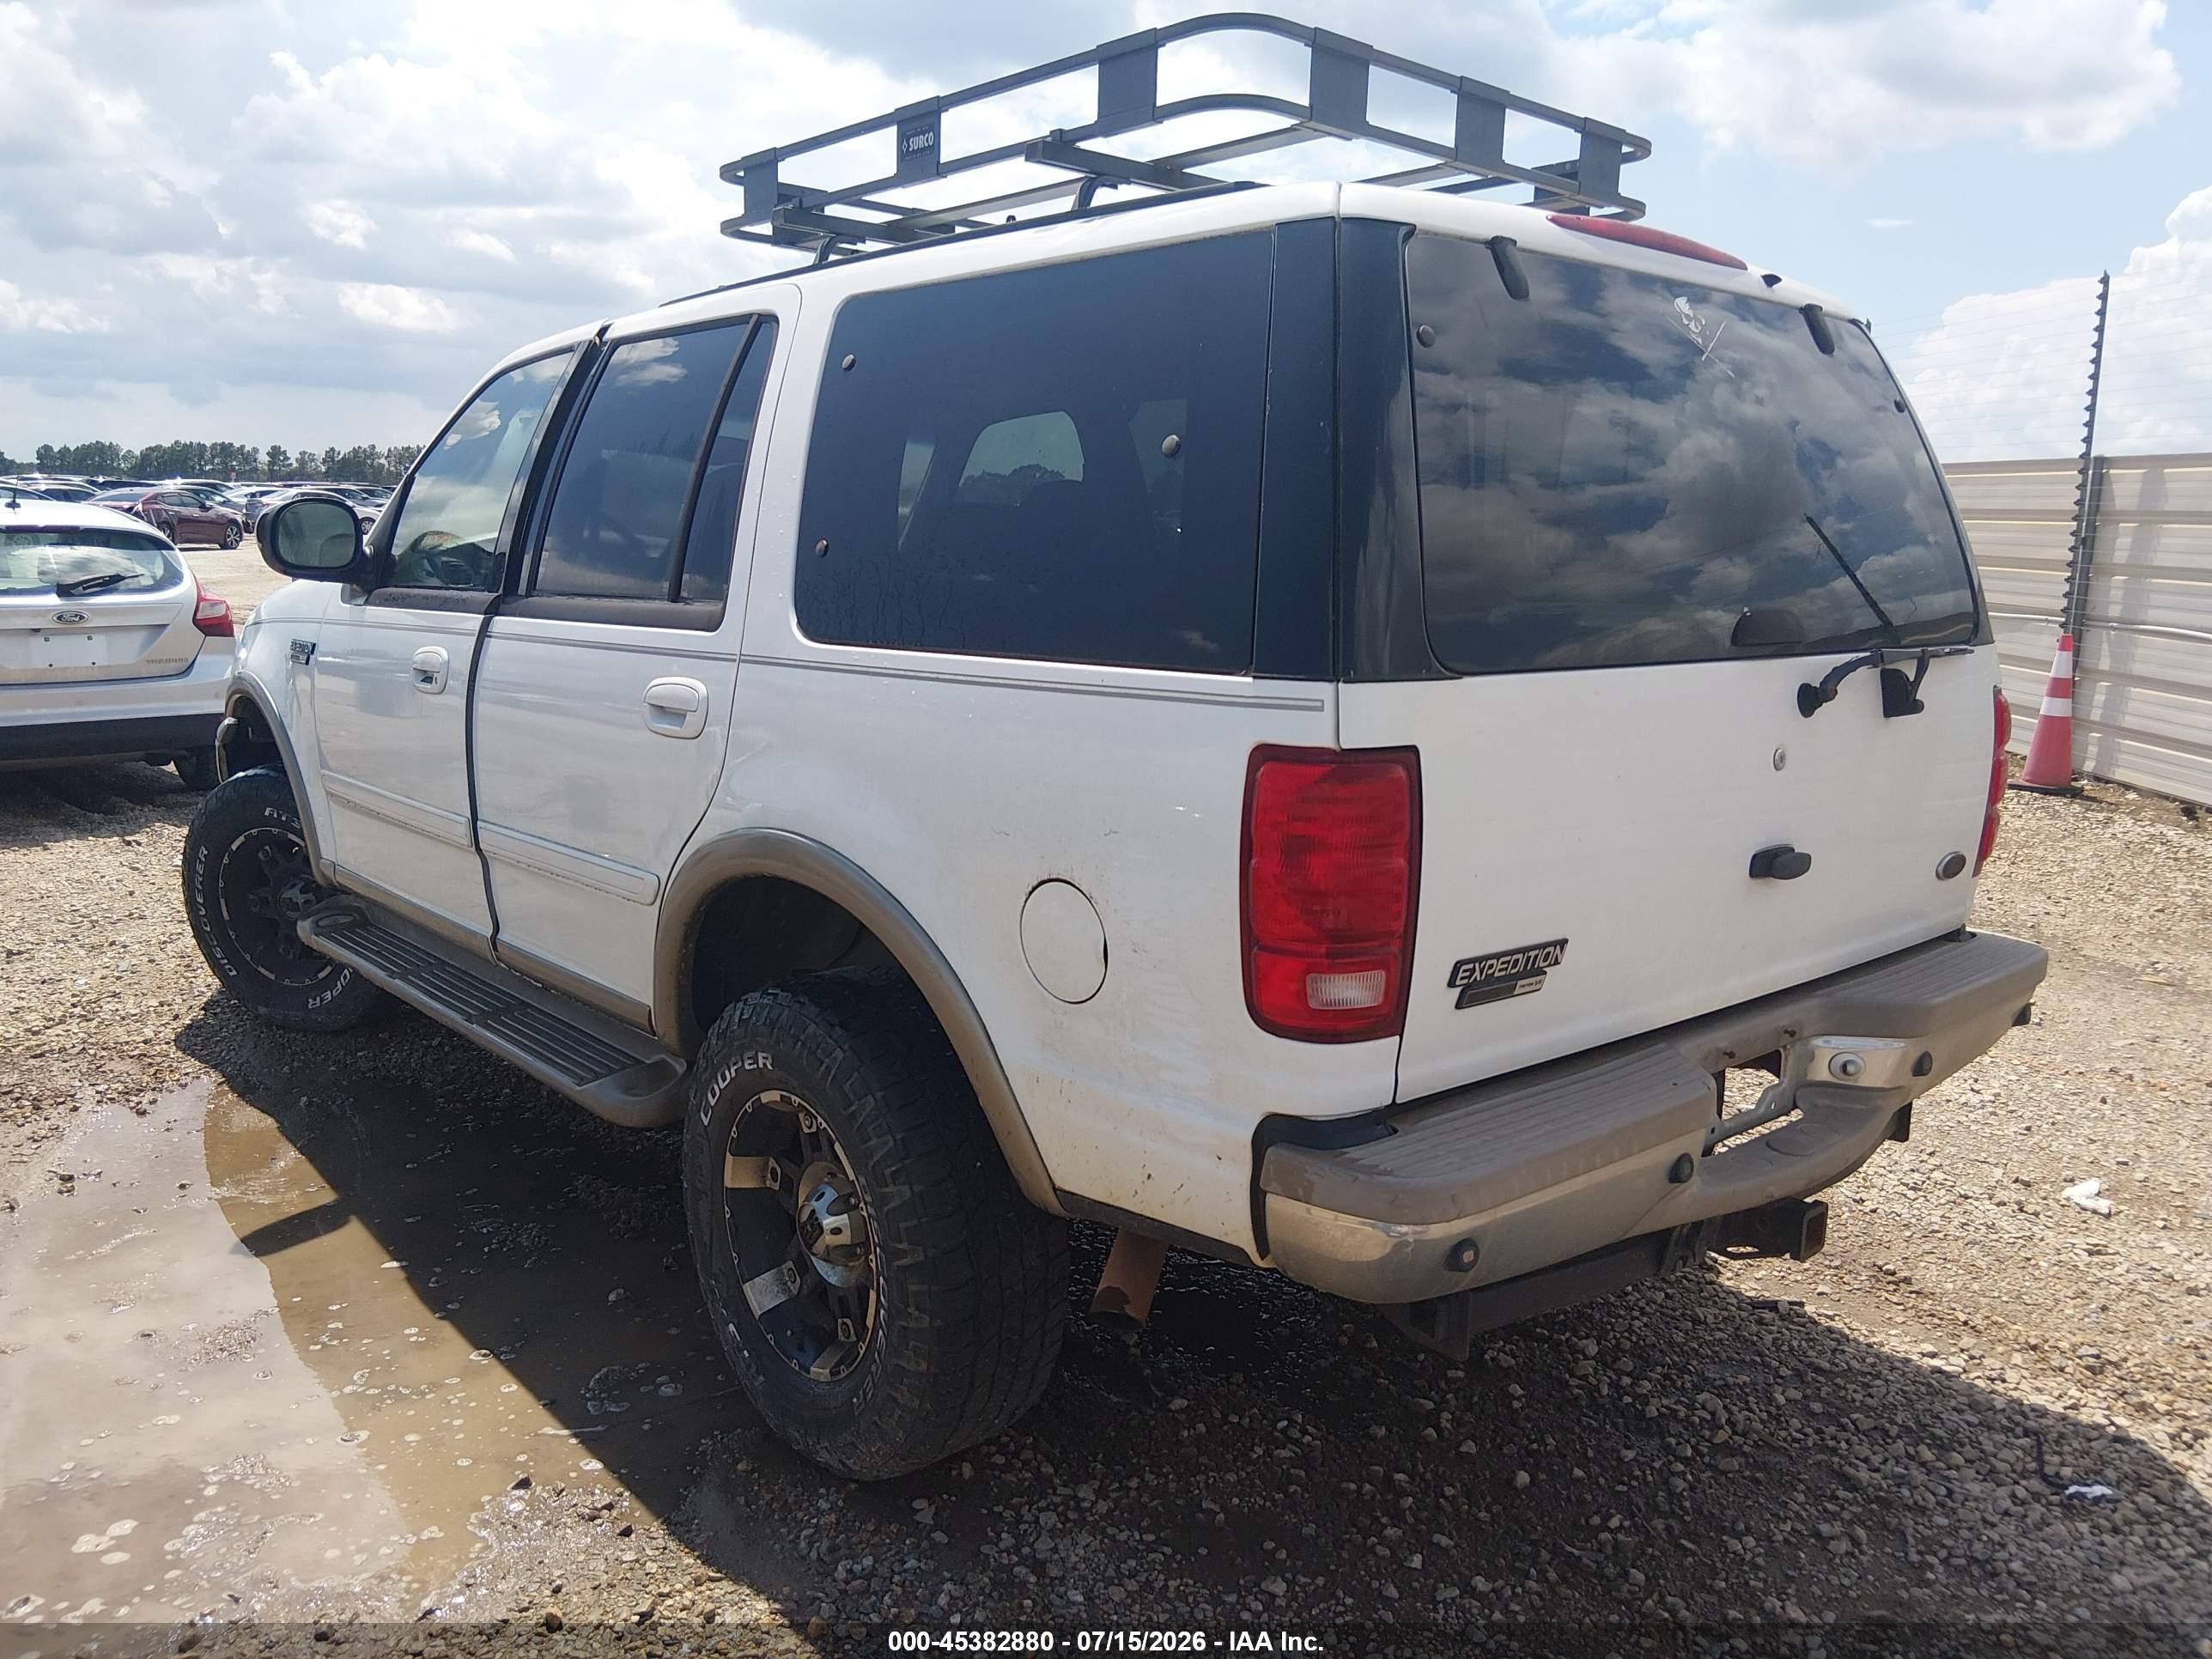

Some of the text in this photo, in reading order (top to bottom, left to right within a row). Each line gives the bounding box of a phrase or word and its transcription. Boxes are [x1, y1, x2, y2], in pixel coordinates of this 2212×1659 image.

[908, 131, 934, 152] SURCO
[195, 846, 239, 976] DISCOVERER
[1455, 943, 1568, 986] EXPEDITION
[307, 968, 353, 1009] OPER
[700, 1052, 775, 1127] COOPER
